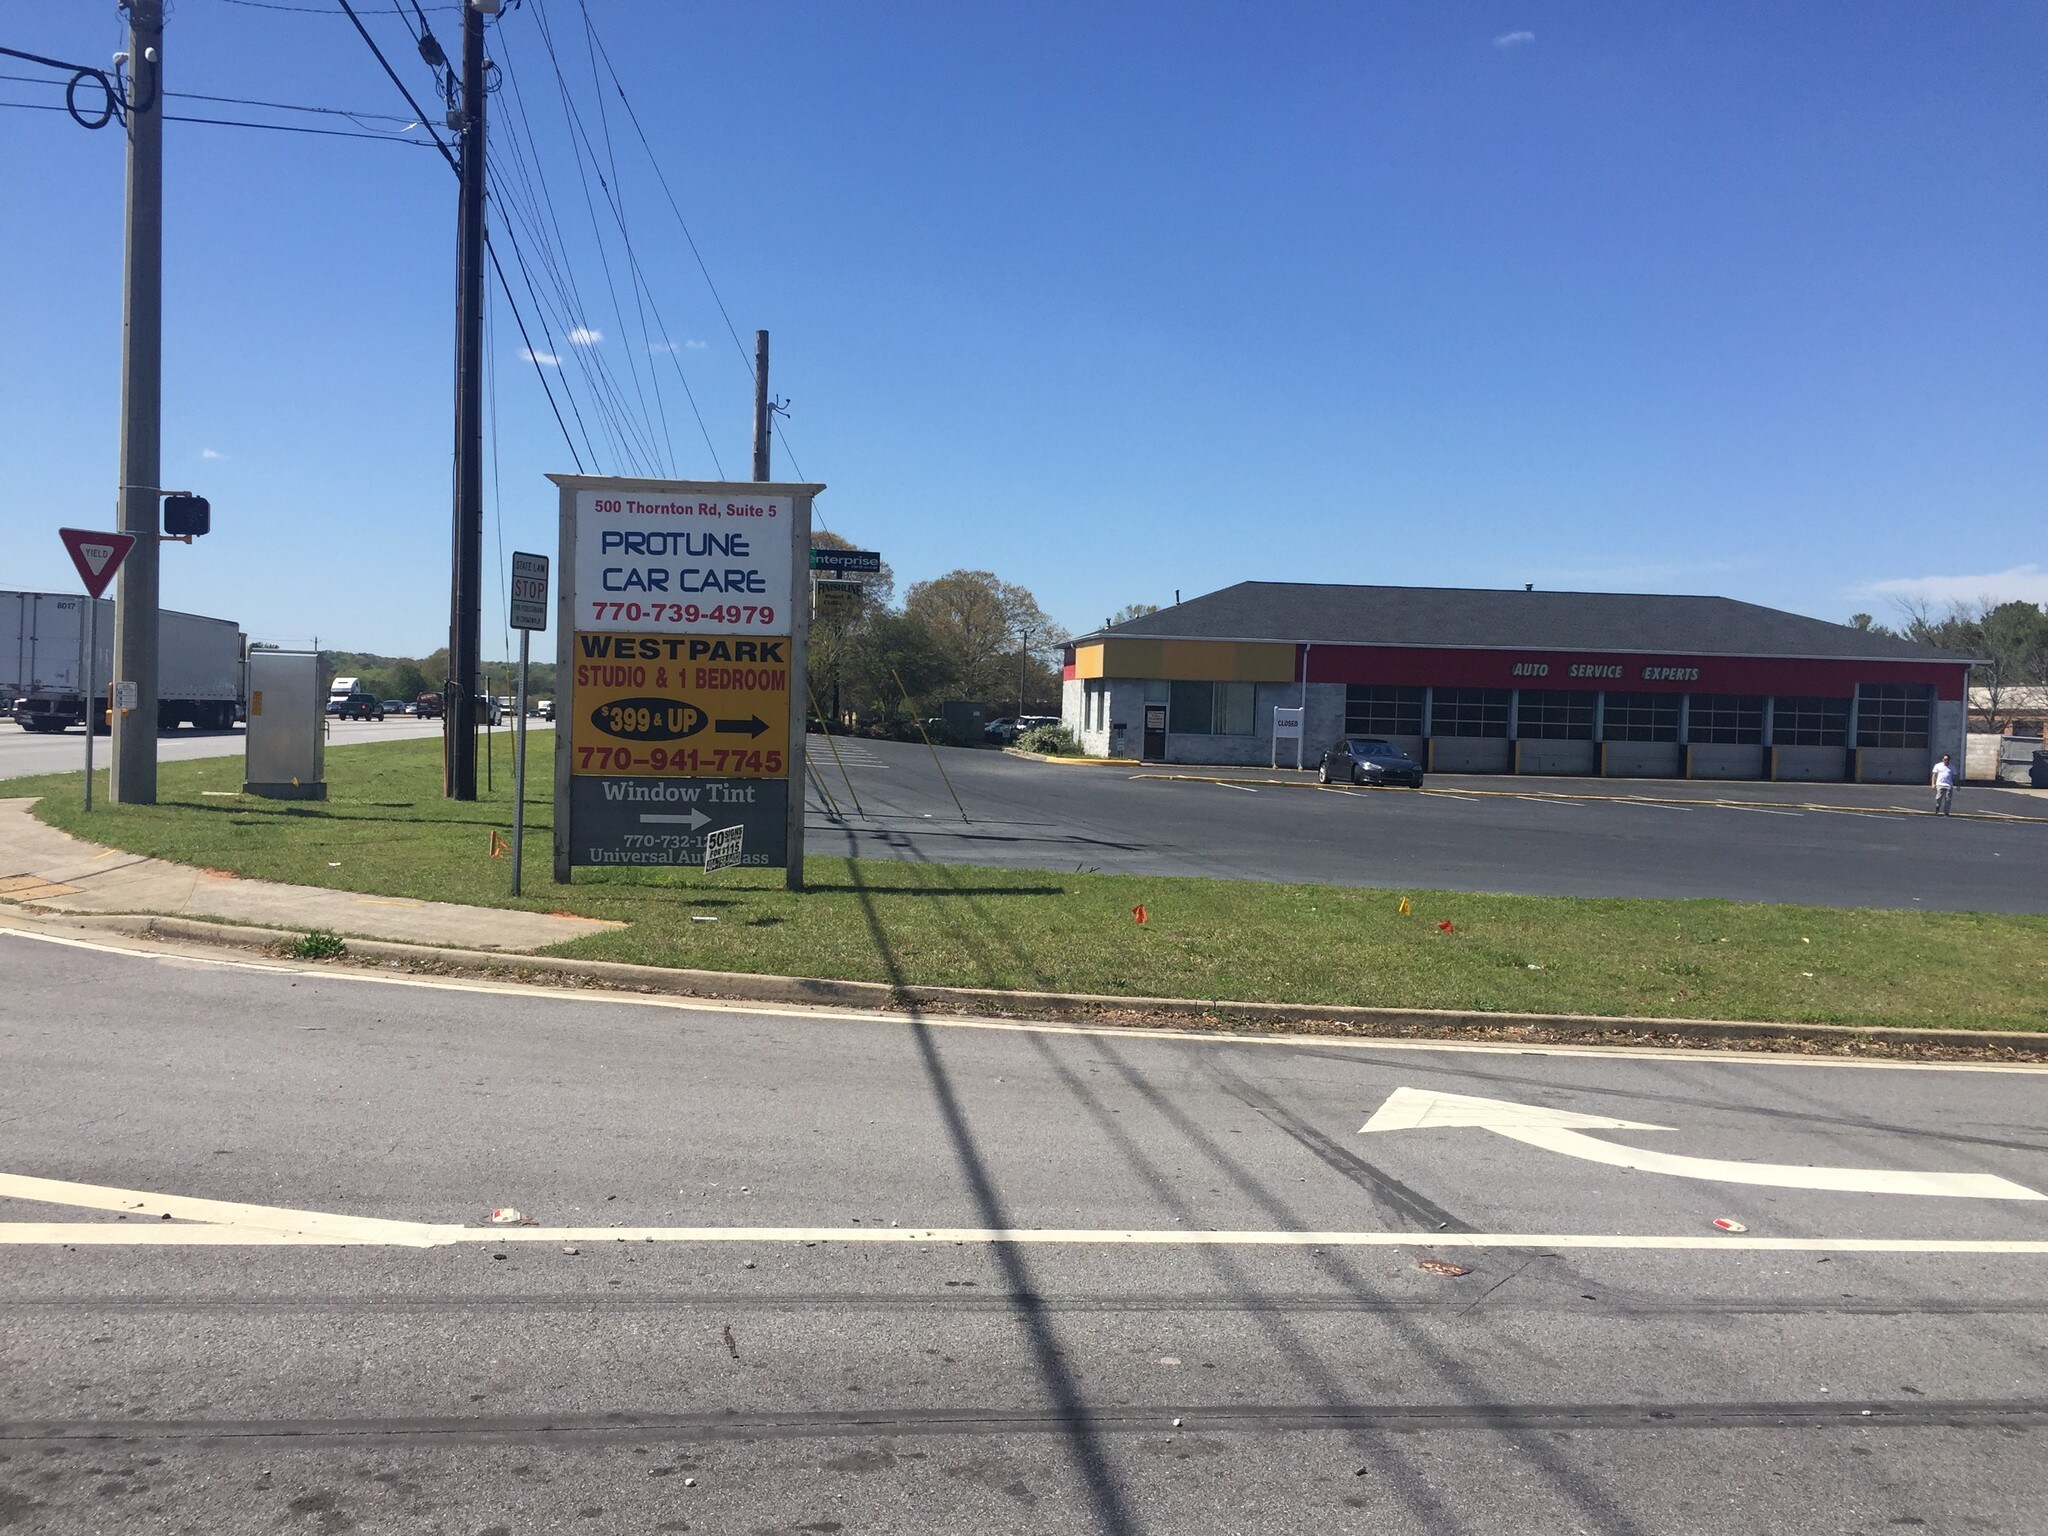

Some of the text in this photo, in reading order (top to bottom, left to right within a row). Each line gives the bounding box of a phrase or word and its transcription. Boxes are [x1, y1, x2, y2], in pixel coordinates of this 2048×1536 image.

[595, 500, 777, 519] 500 Thornton Rd, Suite 5
[86, 549, 108, 558] YIELD
[602, 531, 750, 557] PROTUNE
[516, 561, 546, 573] STATE LAW
[515, 580, 545, 600] STOP
[603, 567, 766, 593] CAR CARE
[56, 602, 76, 610] 8017
[592, 602, 775, 624] 770-739-4979
[577, 664, 786, 691] STUDIO & 1 BEDROOM
[1513, 663, 1699, 680] AUTO SERVICE EXPERTS
[653, 712, 663, 727] &
[667, 708, 698, 733] UP
[577, 747, 782, 772] 770-941-7745
[602, 781, 756, 803] Window Tint
[708, 831, 725, 849] 50
[724, 827, 743, 839] SIGNS
[590, 848, 673, 864] Universal
[678, 849, 708, 864] Aut
[742, 852, 769, 864] ass
[710, 841, 740, 858] FOR $115
